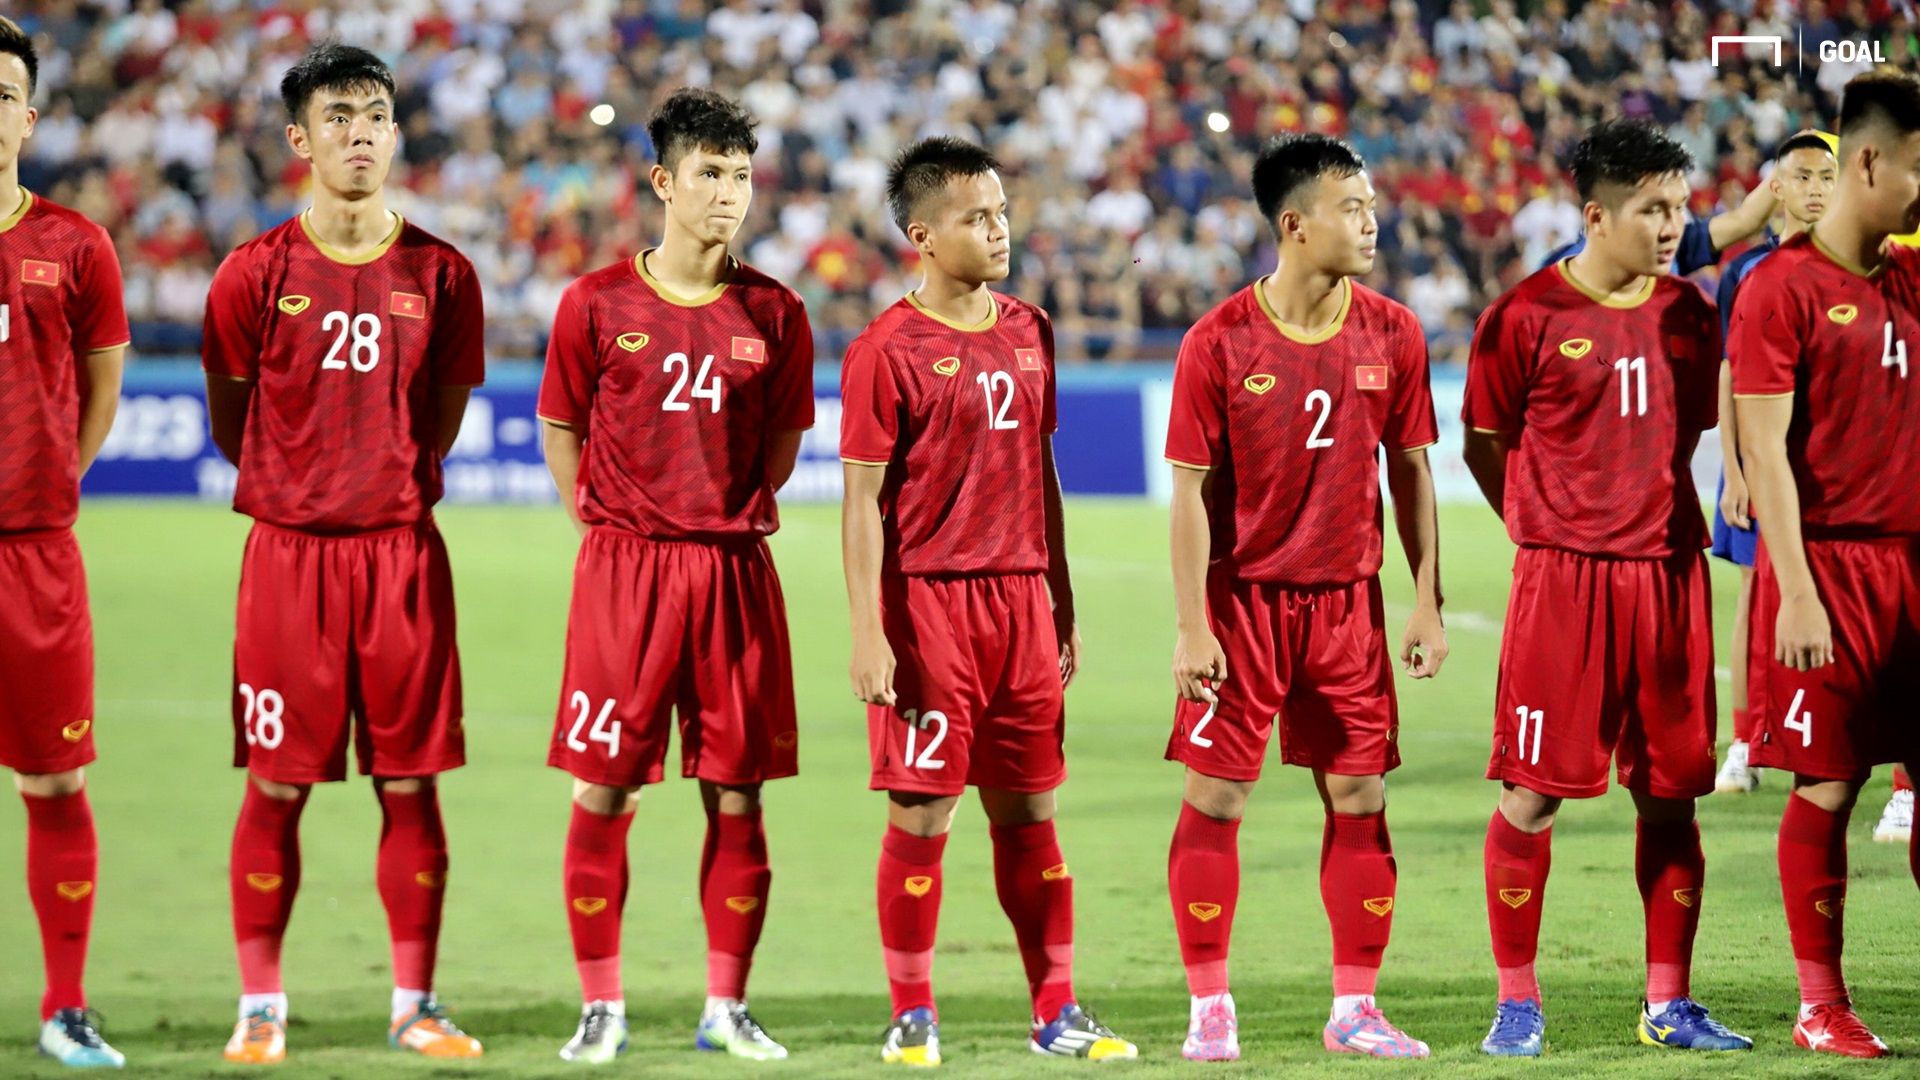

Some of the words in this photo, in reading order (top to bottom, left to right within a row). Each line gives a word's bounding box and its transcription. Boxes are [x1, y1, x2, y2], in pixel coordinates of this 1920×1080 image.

[321, 310, 382, 373] 28
[1881, 321, 1908, 379] 4
[661, 351, 722, 414] 24
[976, 370, 1019, 430] 12
[1614, 355, 1648, 418] 11
[1304, 388, 1335, 450] 2
[238, 682, 285, 751] 28
[566, 689, 622, 759] 24
[903, 708, 949, 770] 12
[1515, 705, 1544, 766] 11
[1783, 688, 1812, 748] 4
